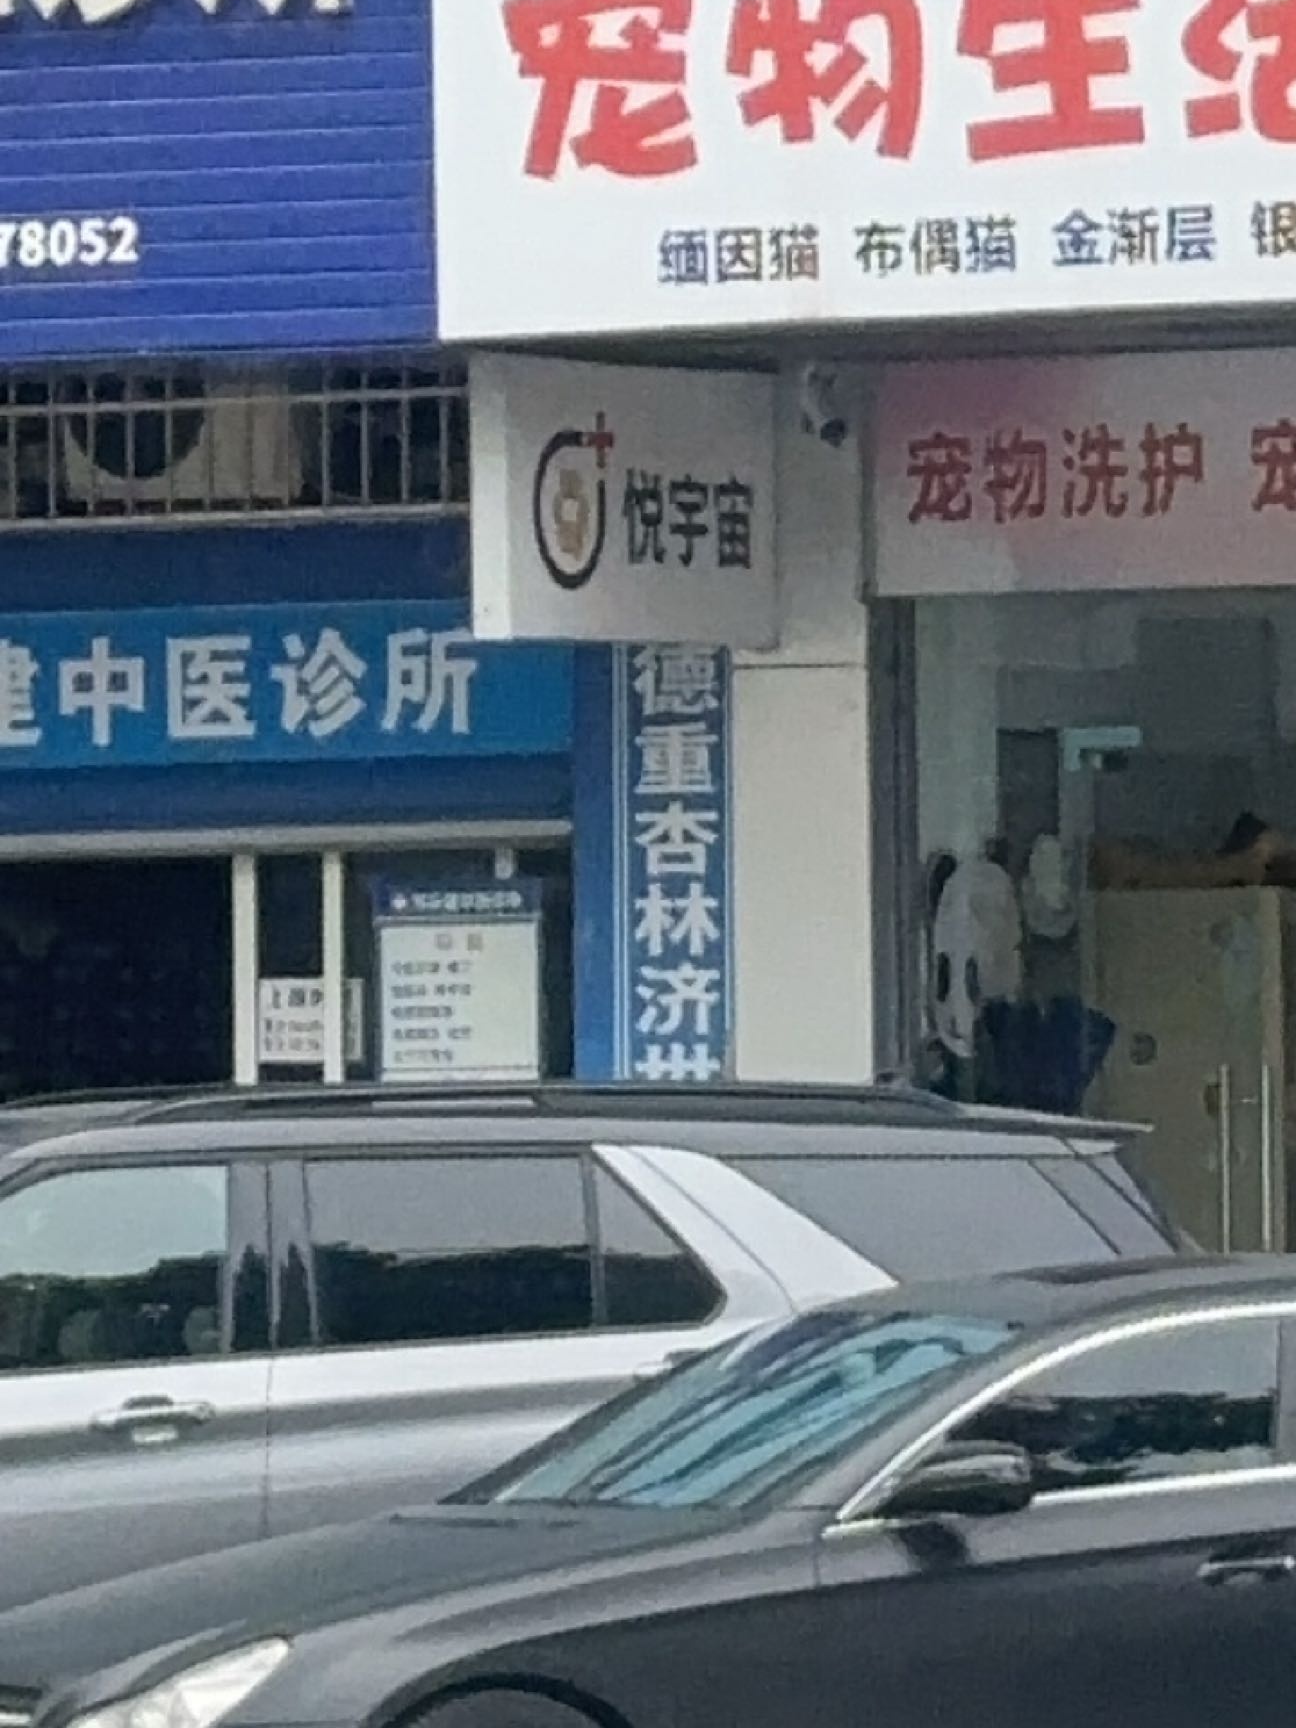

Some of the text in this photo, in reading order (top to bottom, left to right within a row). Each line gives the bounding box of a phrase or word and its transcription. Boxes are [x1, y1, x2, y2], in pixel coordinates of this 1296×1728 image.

[657, 222, 820, 286] 缅因猫
[854, 214, 1018, 277] 布偶猫
[1052, 204, 1217, 267] 金渐层
[621, 467, 756, 570] 悦宇宙
[906, 423, 1206, 524] 宠物洗护
